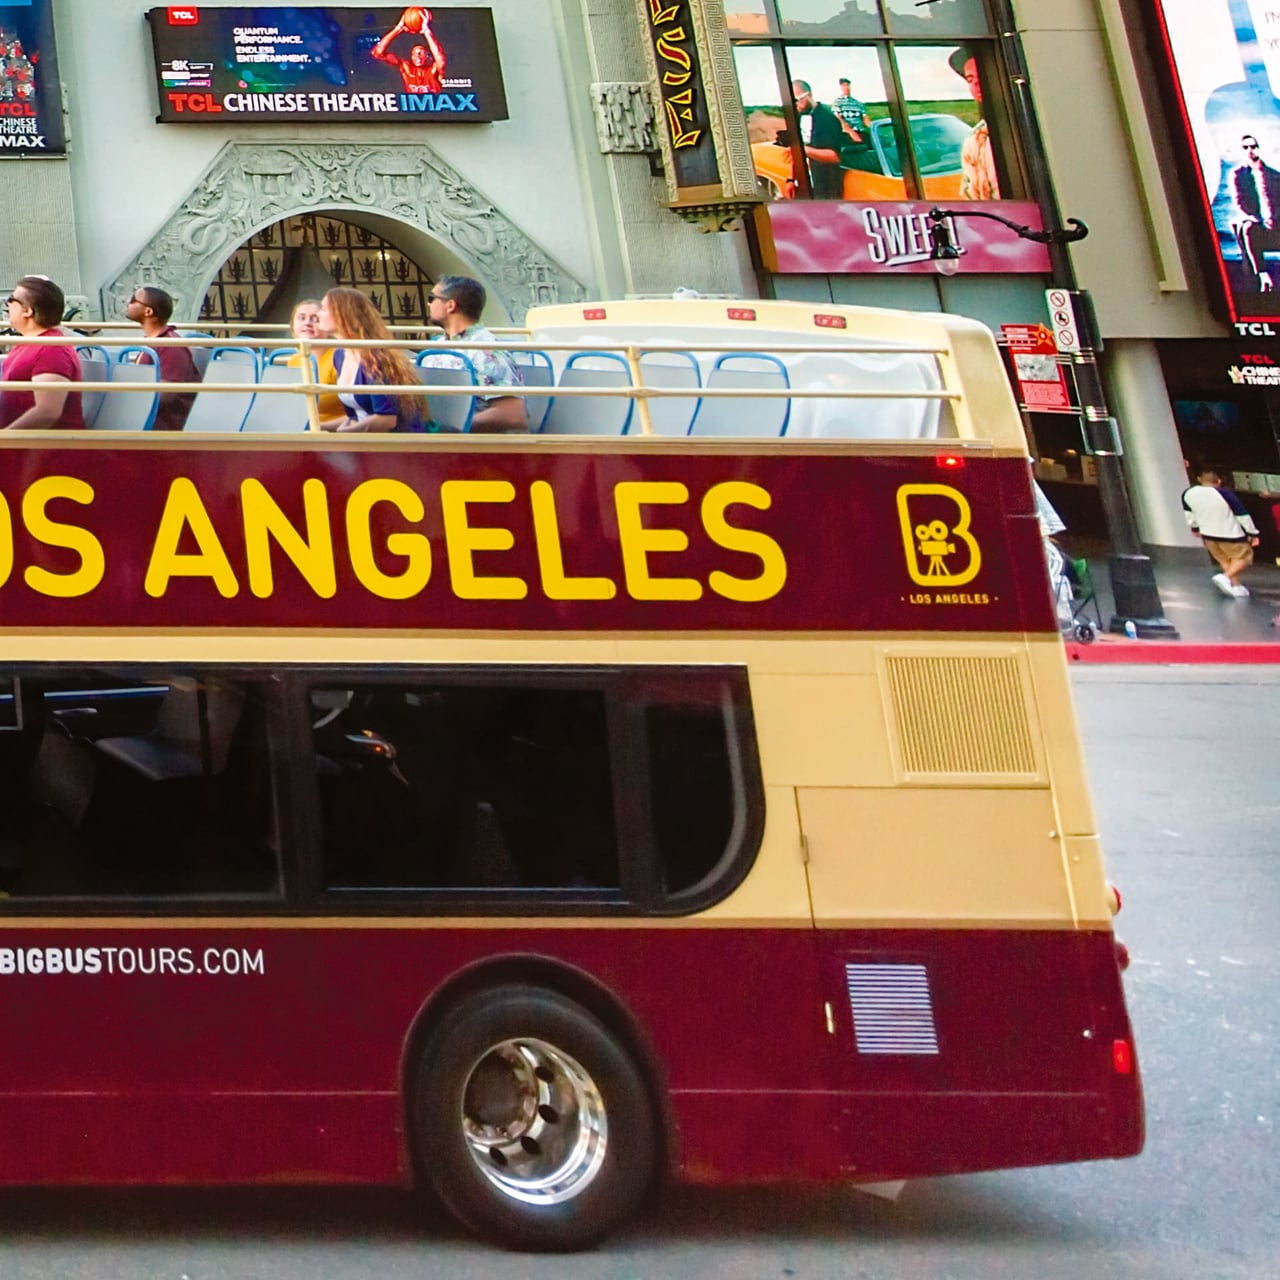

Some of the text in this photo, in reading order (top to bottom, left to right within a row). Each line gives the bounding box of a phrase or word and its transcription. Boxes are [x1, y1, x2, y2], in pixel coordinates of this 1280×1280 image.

[173, 11, 194, 19] TCL
[233, 27, 278, 35] QUANTUM
[234, 36, 303, 44] PERFORMANCE.
[235, 46, 275, 54] ENDLESS
[236, 54, 312, 63] ENTERTAINMENT.
[171, 60, 189, 71] 8K
[168, 93, 478, 113] TCL CHINESE THEATRE IMAX
[1234, 322, 1277, 336] TCL
[1240, 354, 1276, 365] TCL
[143, 476, 788, 602] ANGELES
[909, 593, 990, 604] LOS ANGELES
